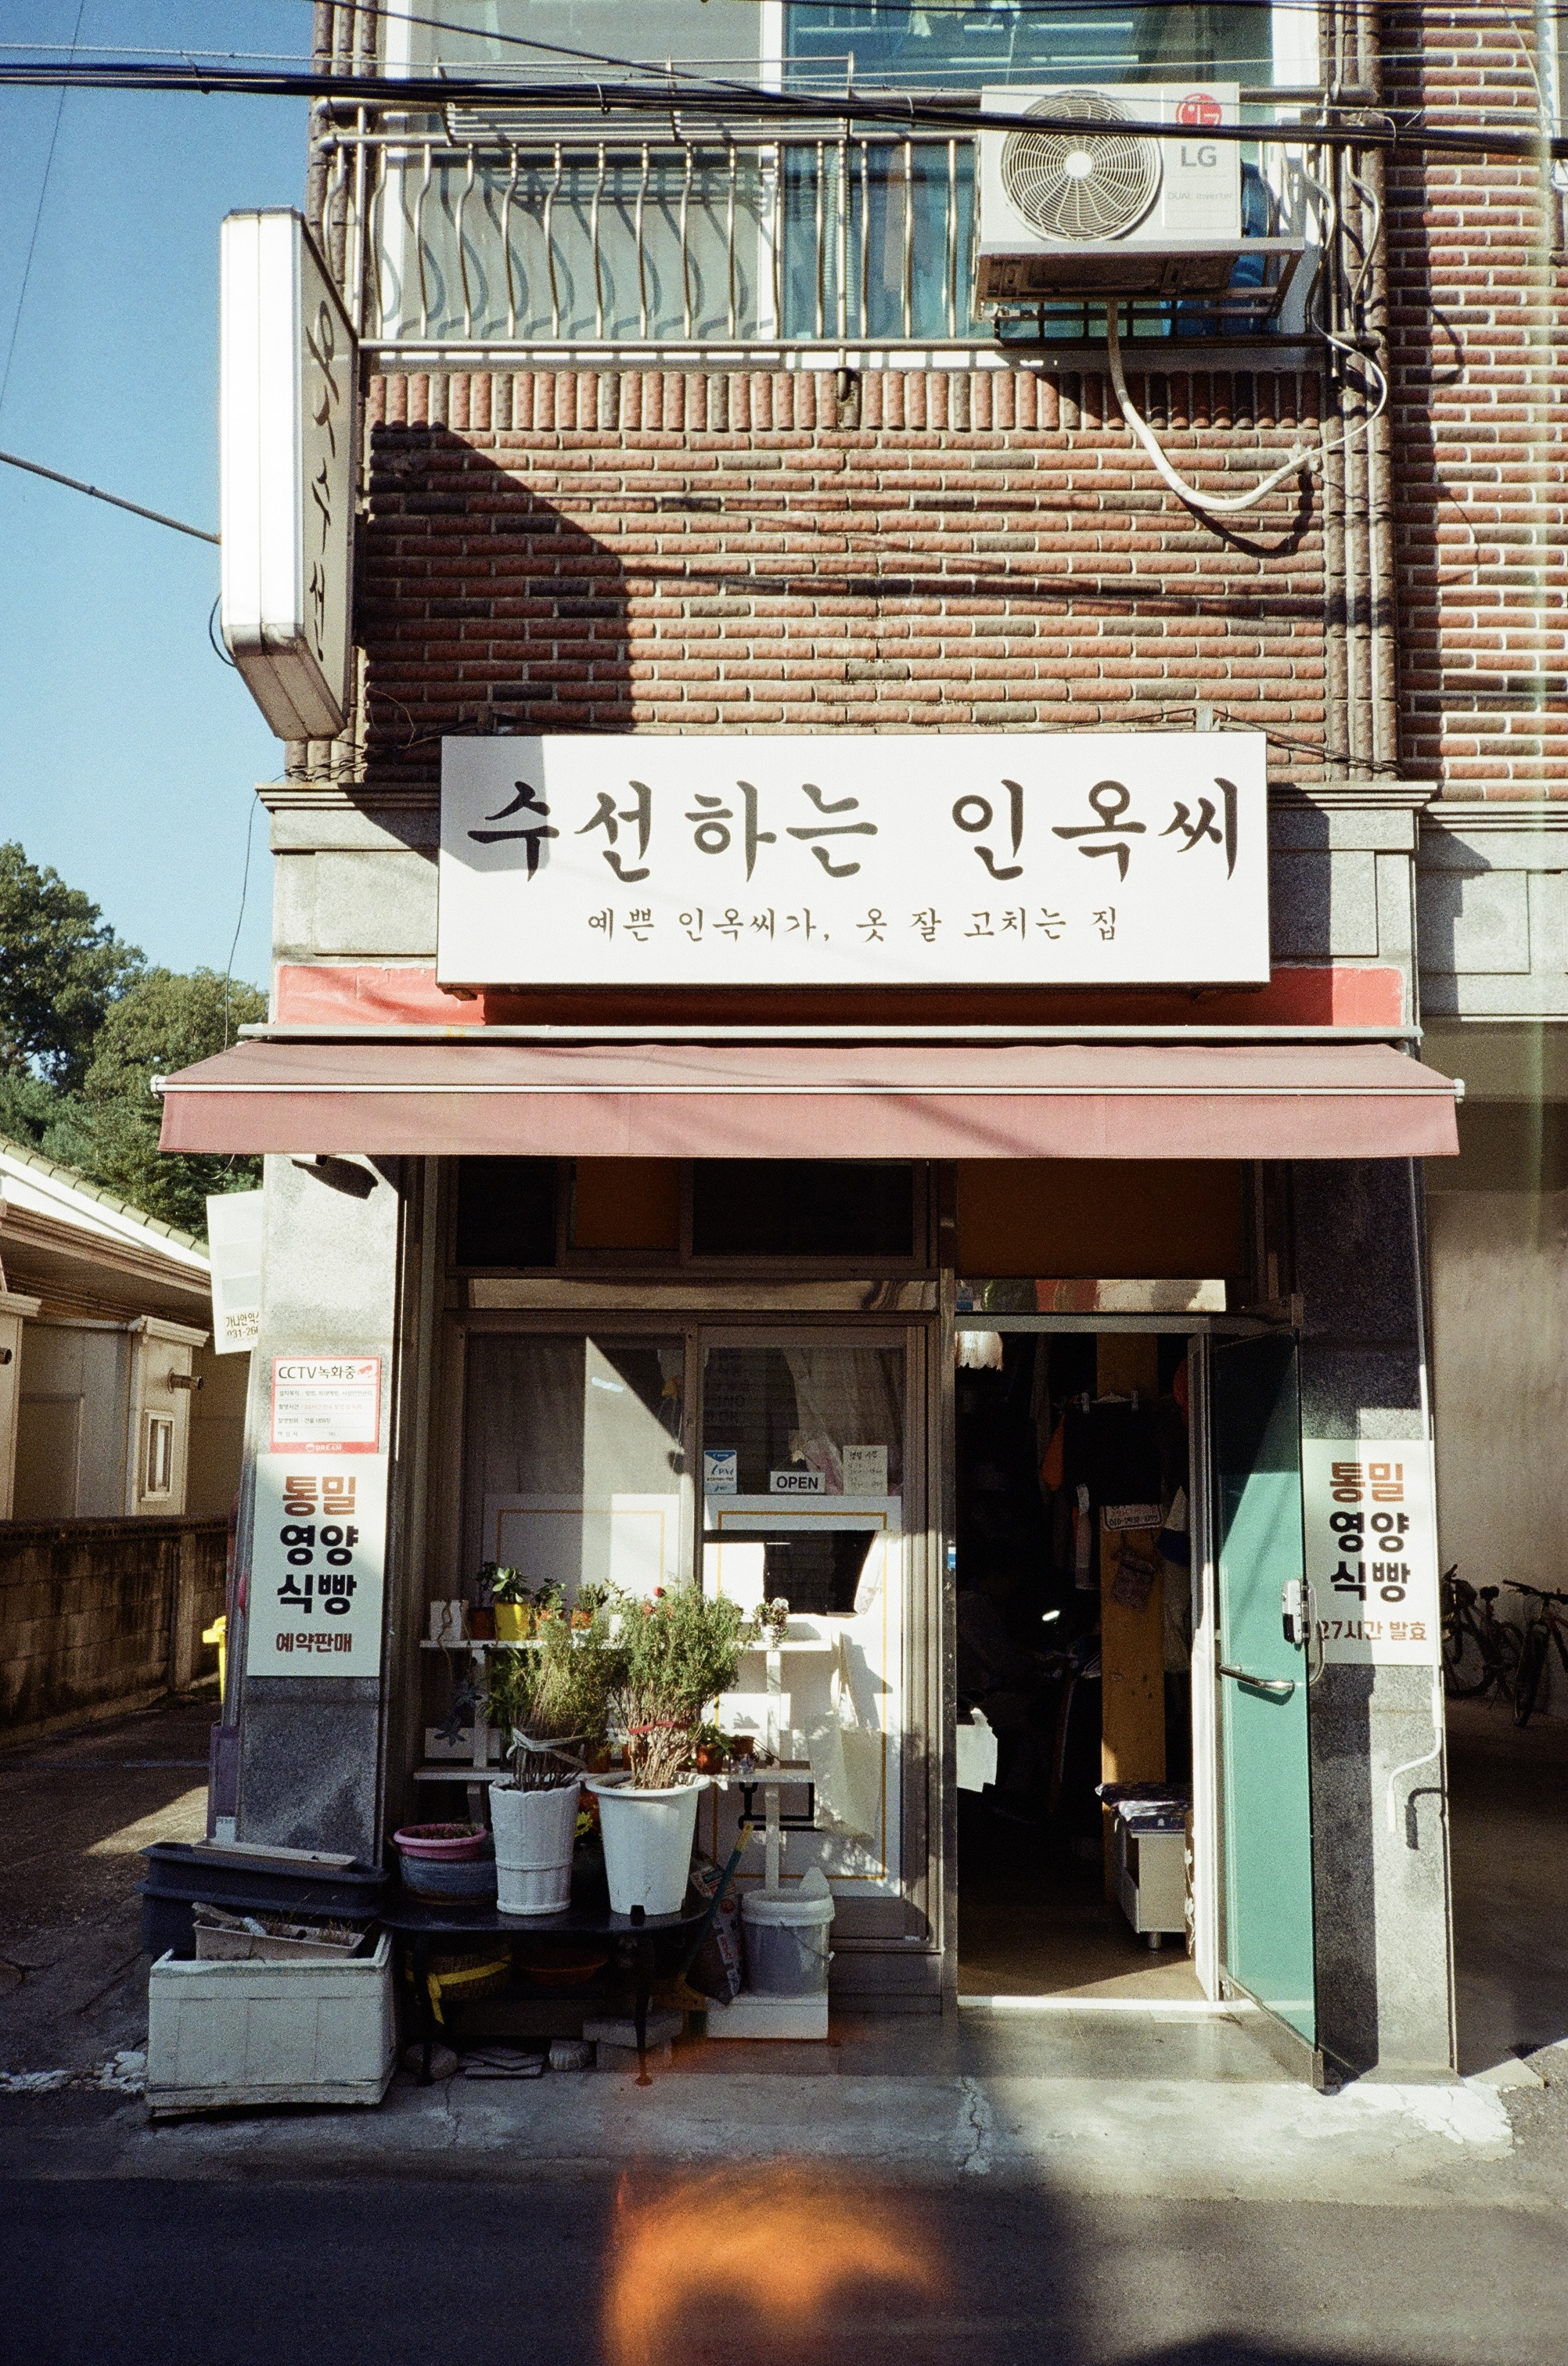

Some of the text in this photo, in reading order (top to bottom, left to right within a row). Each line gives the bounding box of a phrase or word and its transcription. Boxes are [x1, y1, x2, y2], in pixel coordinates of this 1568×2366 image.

[1181, 146, 1217, 167] LG
[467, 778, 1238, 883] 수선하는 인옥씨
[588, 907, 1117, 943] 예쁜 인옥씨가, 옷 잘 고치는 집
[282, 1476, 356, 1517] 통밀
[776, 1476, 818, 1490] OPEN
[1329, 1462, 1404, 1504] 통밀
[279, 1524, 358, 1566] 영양
[1329, 1511, 1409, 1553] 영양
[277, 1573, 357, 1616] 식빵
[1330, 1560, 1411, 1602] 식빵
[275, 1633, 352, 1653] 예약판매
[1389, 1620, 1427, 1641] 발효
